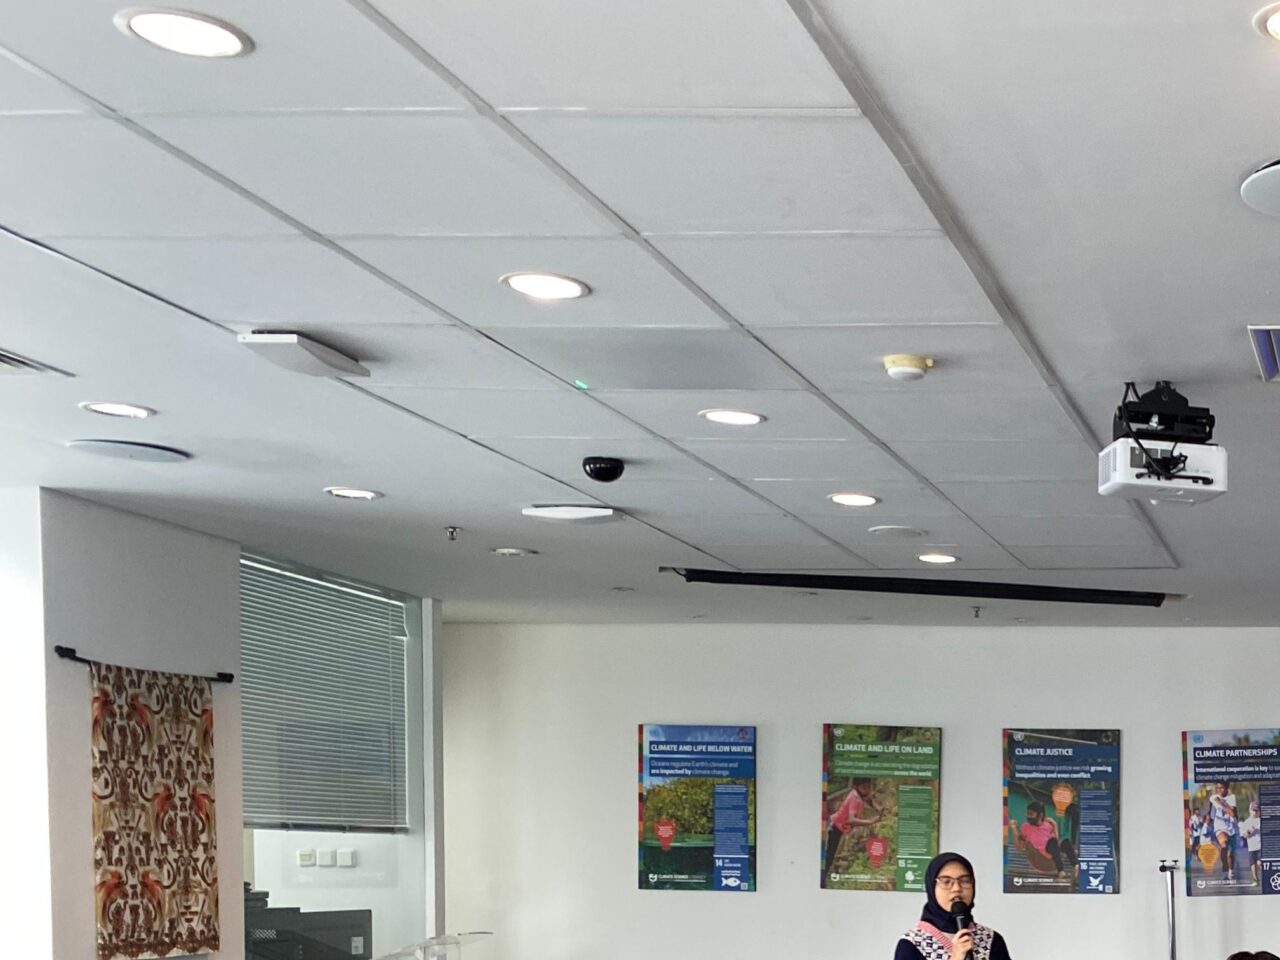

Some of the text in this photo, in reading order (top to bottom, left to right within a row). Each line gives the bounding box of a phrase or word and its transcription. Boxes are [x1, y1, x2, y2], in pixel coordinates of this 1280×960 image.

[651, 744, 677, 752] CLIMATE
[693, 745, 706, 753] LIFE
[707, 745, 730, 753] BELOW
[835, 743, 934, 754] CLIMATE AND LIFE ON LAND
[1015, 748, 1073, 756] CLIMATE JUSTICE
[1195, 748, 1278, 758] CLIMATE PARTNERSHIPS
[715, 859, 723, 867] 14
[1263, 862, 1270, 870] 17
